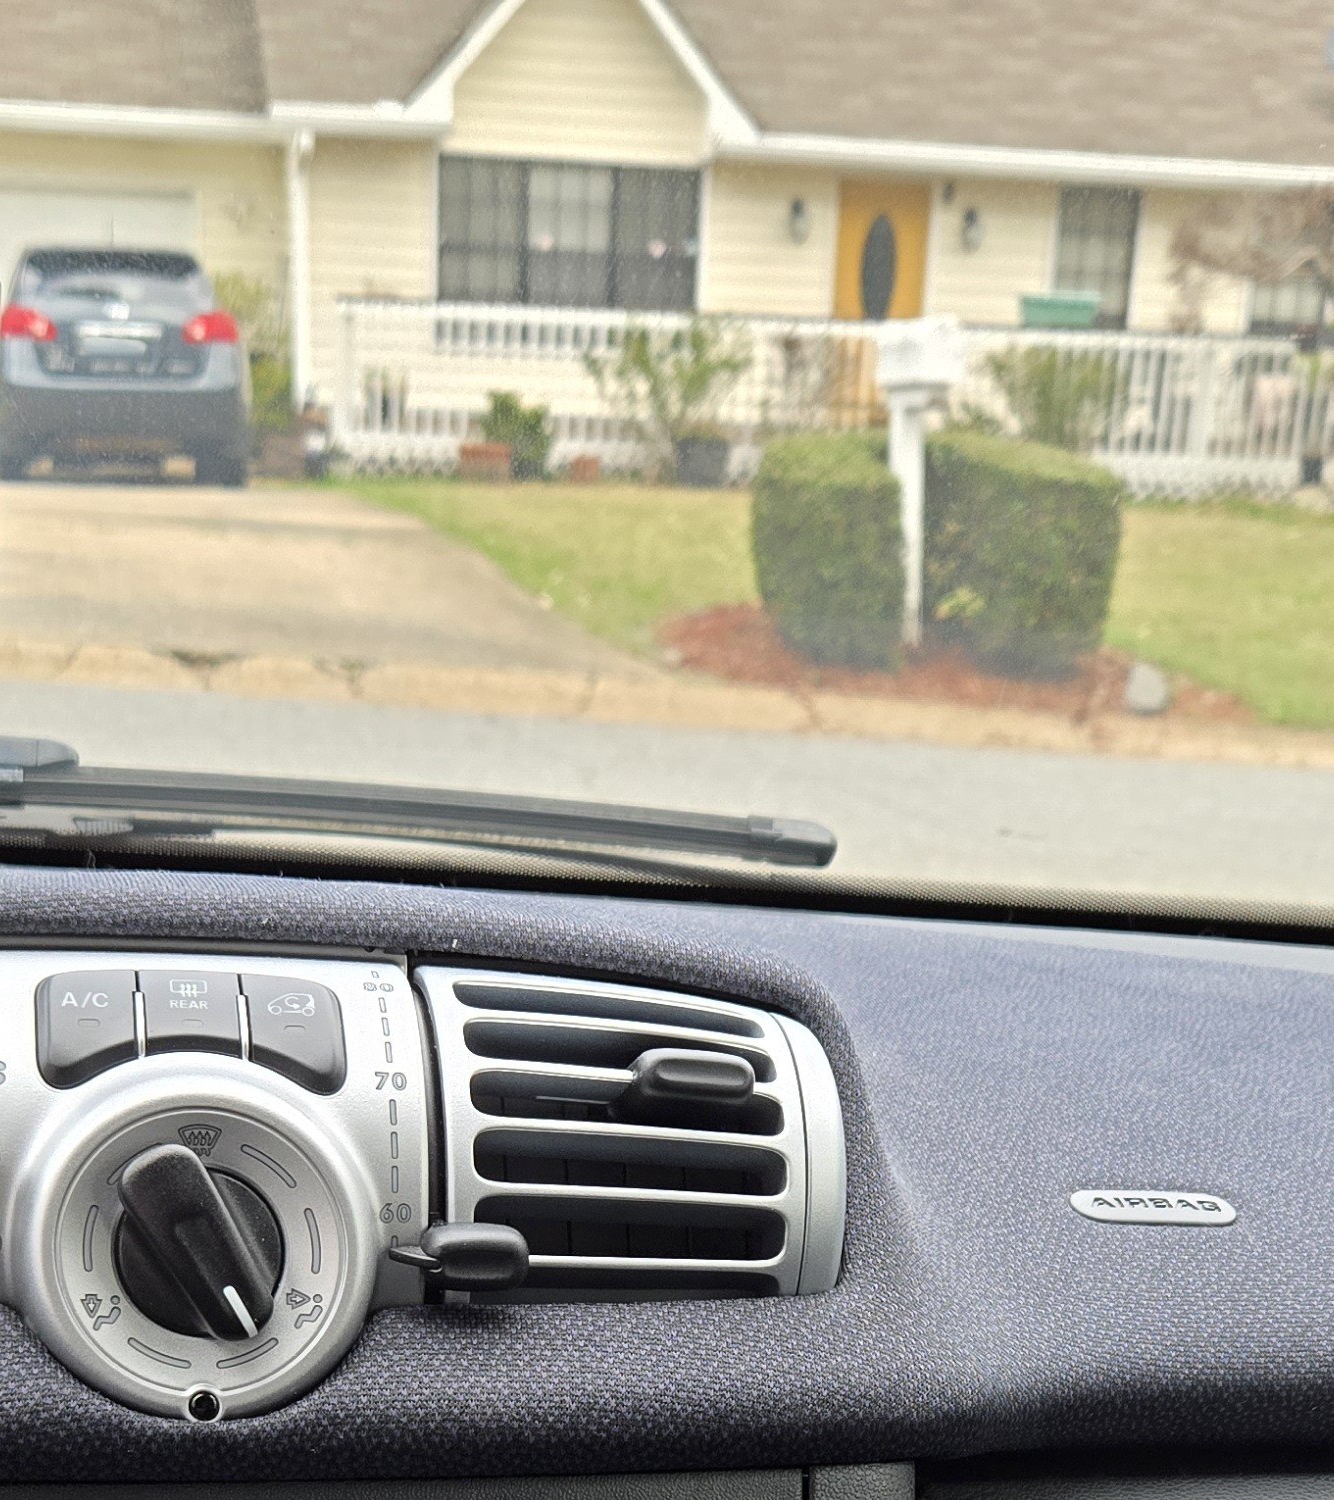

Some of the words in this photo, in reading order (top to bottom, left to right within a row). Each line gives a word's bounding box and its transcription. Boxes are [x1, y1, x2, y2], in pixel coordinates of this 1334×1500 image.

[61, 992, 109, 1008] A/C
[169, 1000, 208, 1009] REAR
[375, 1072, 407, 1090] 70
[1091, 1196, 1222, 1212] AIRBAG
[379, 1203, 411, 1223] 60
